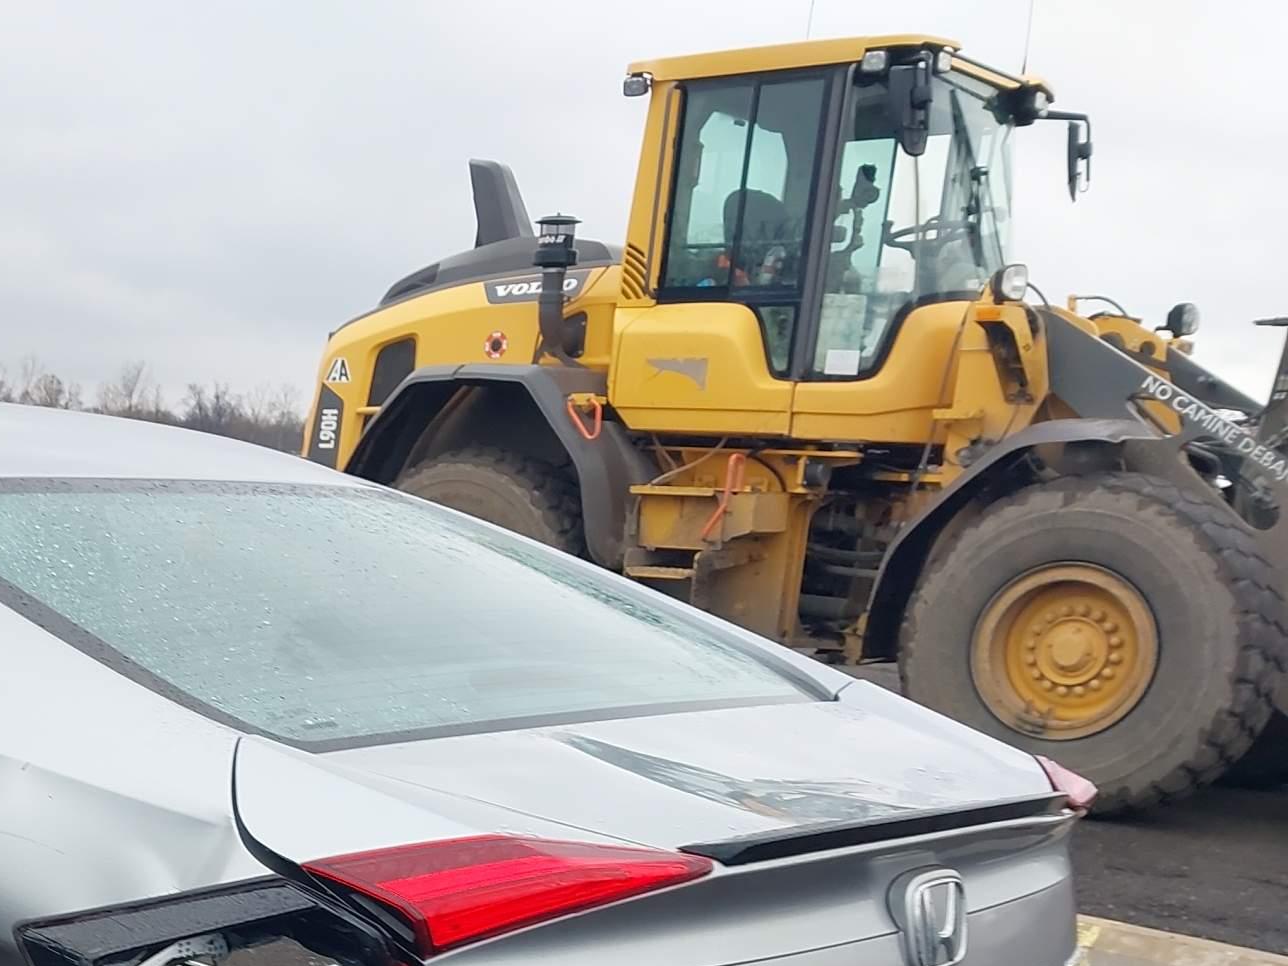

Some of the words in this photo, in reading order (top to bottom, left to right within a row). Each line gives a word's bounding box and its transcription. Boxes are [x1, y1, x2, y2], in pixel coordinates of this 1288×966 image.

[495, 278, 578, 297] VOLO
[318, 408, 339, 449] L90H
[1142, 375, 1173, 400] NO
[1172, 396, 1239, 444] CAMINE
